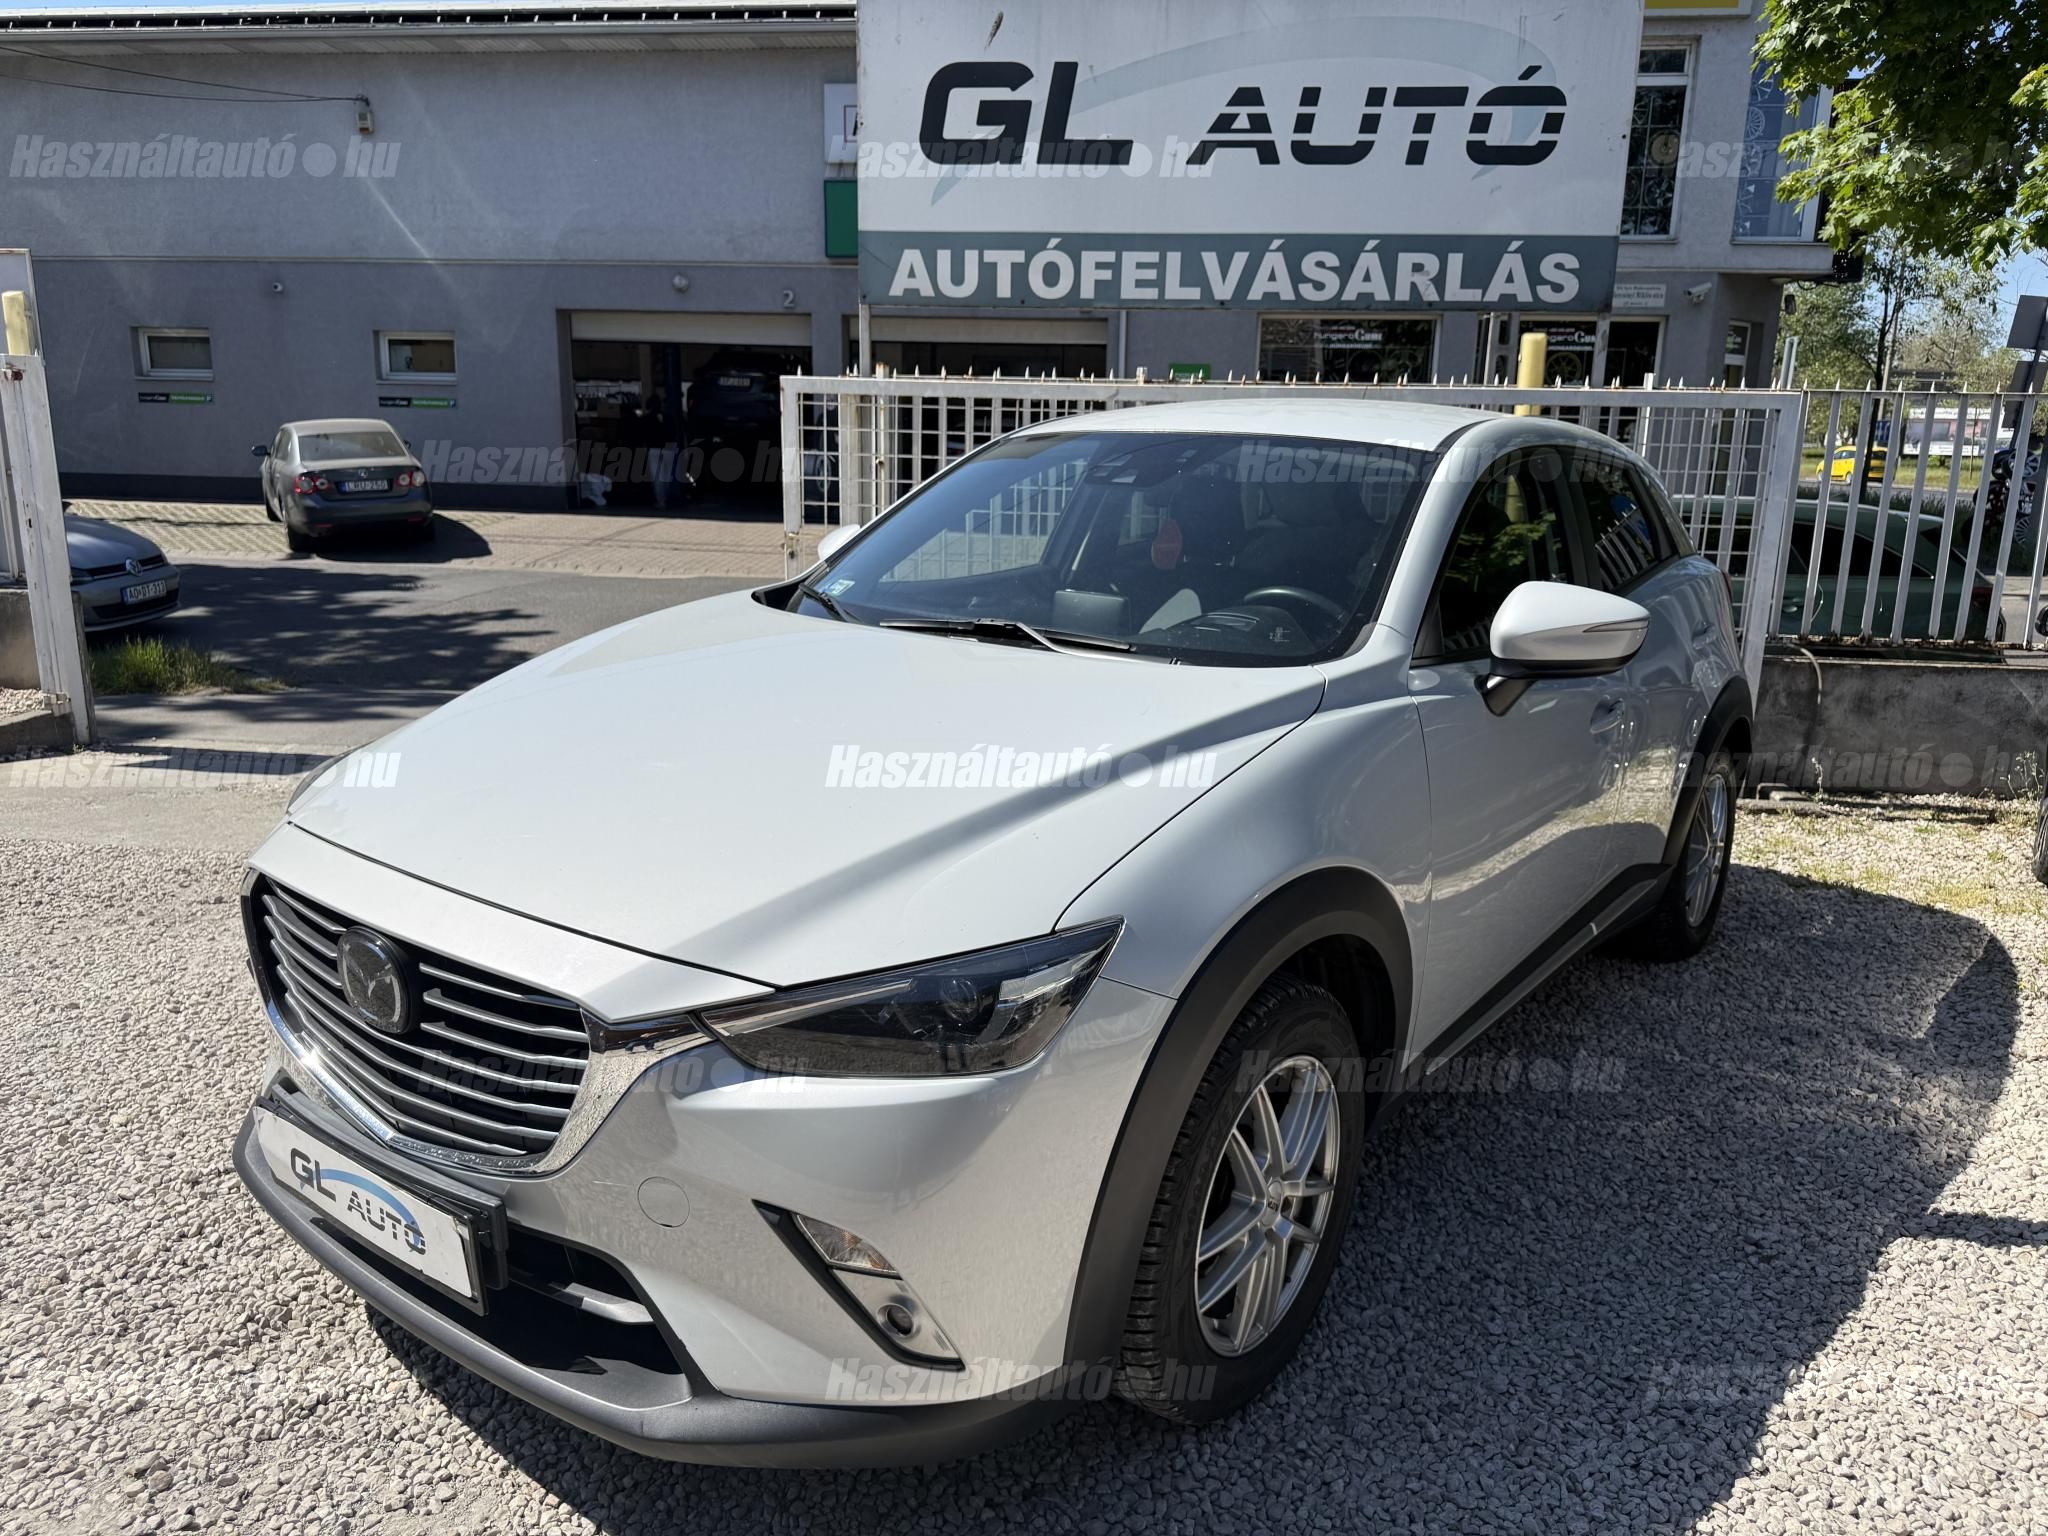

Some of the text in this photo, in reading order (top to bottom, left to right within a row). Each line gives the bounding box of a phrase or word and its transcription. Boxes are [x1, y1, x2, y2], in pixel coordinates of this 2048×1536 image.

[919, 61, 1134, 166] GL
[1186, 64, 1568, 166] AUTÓ
[783, 289, 795, 307] 2
[888, 237, 1580, 303] AUTÓFELVÁSÁRLÁS
[290, 1147, 337, 1203] GL
